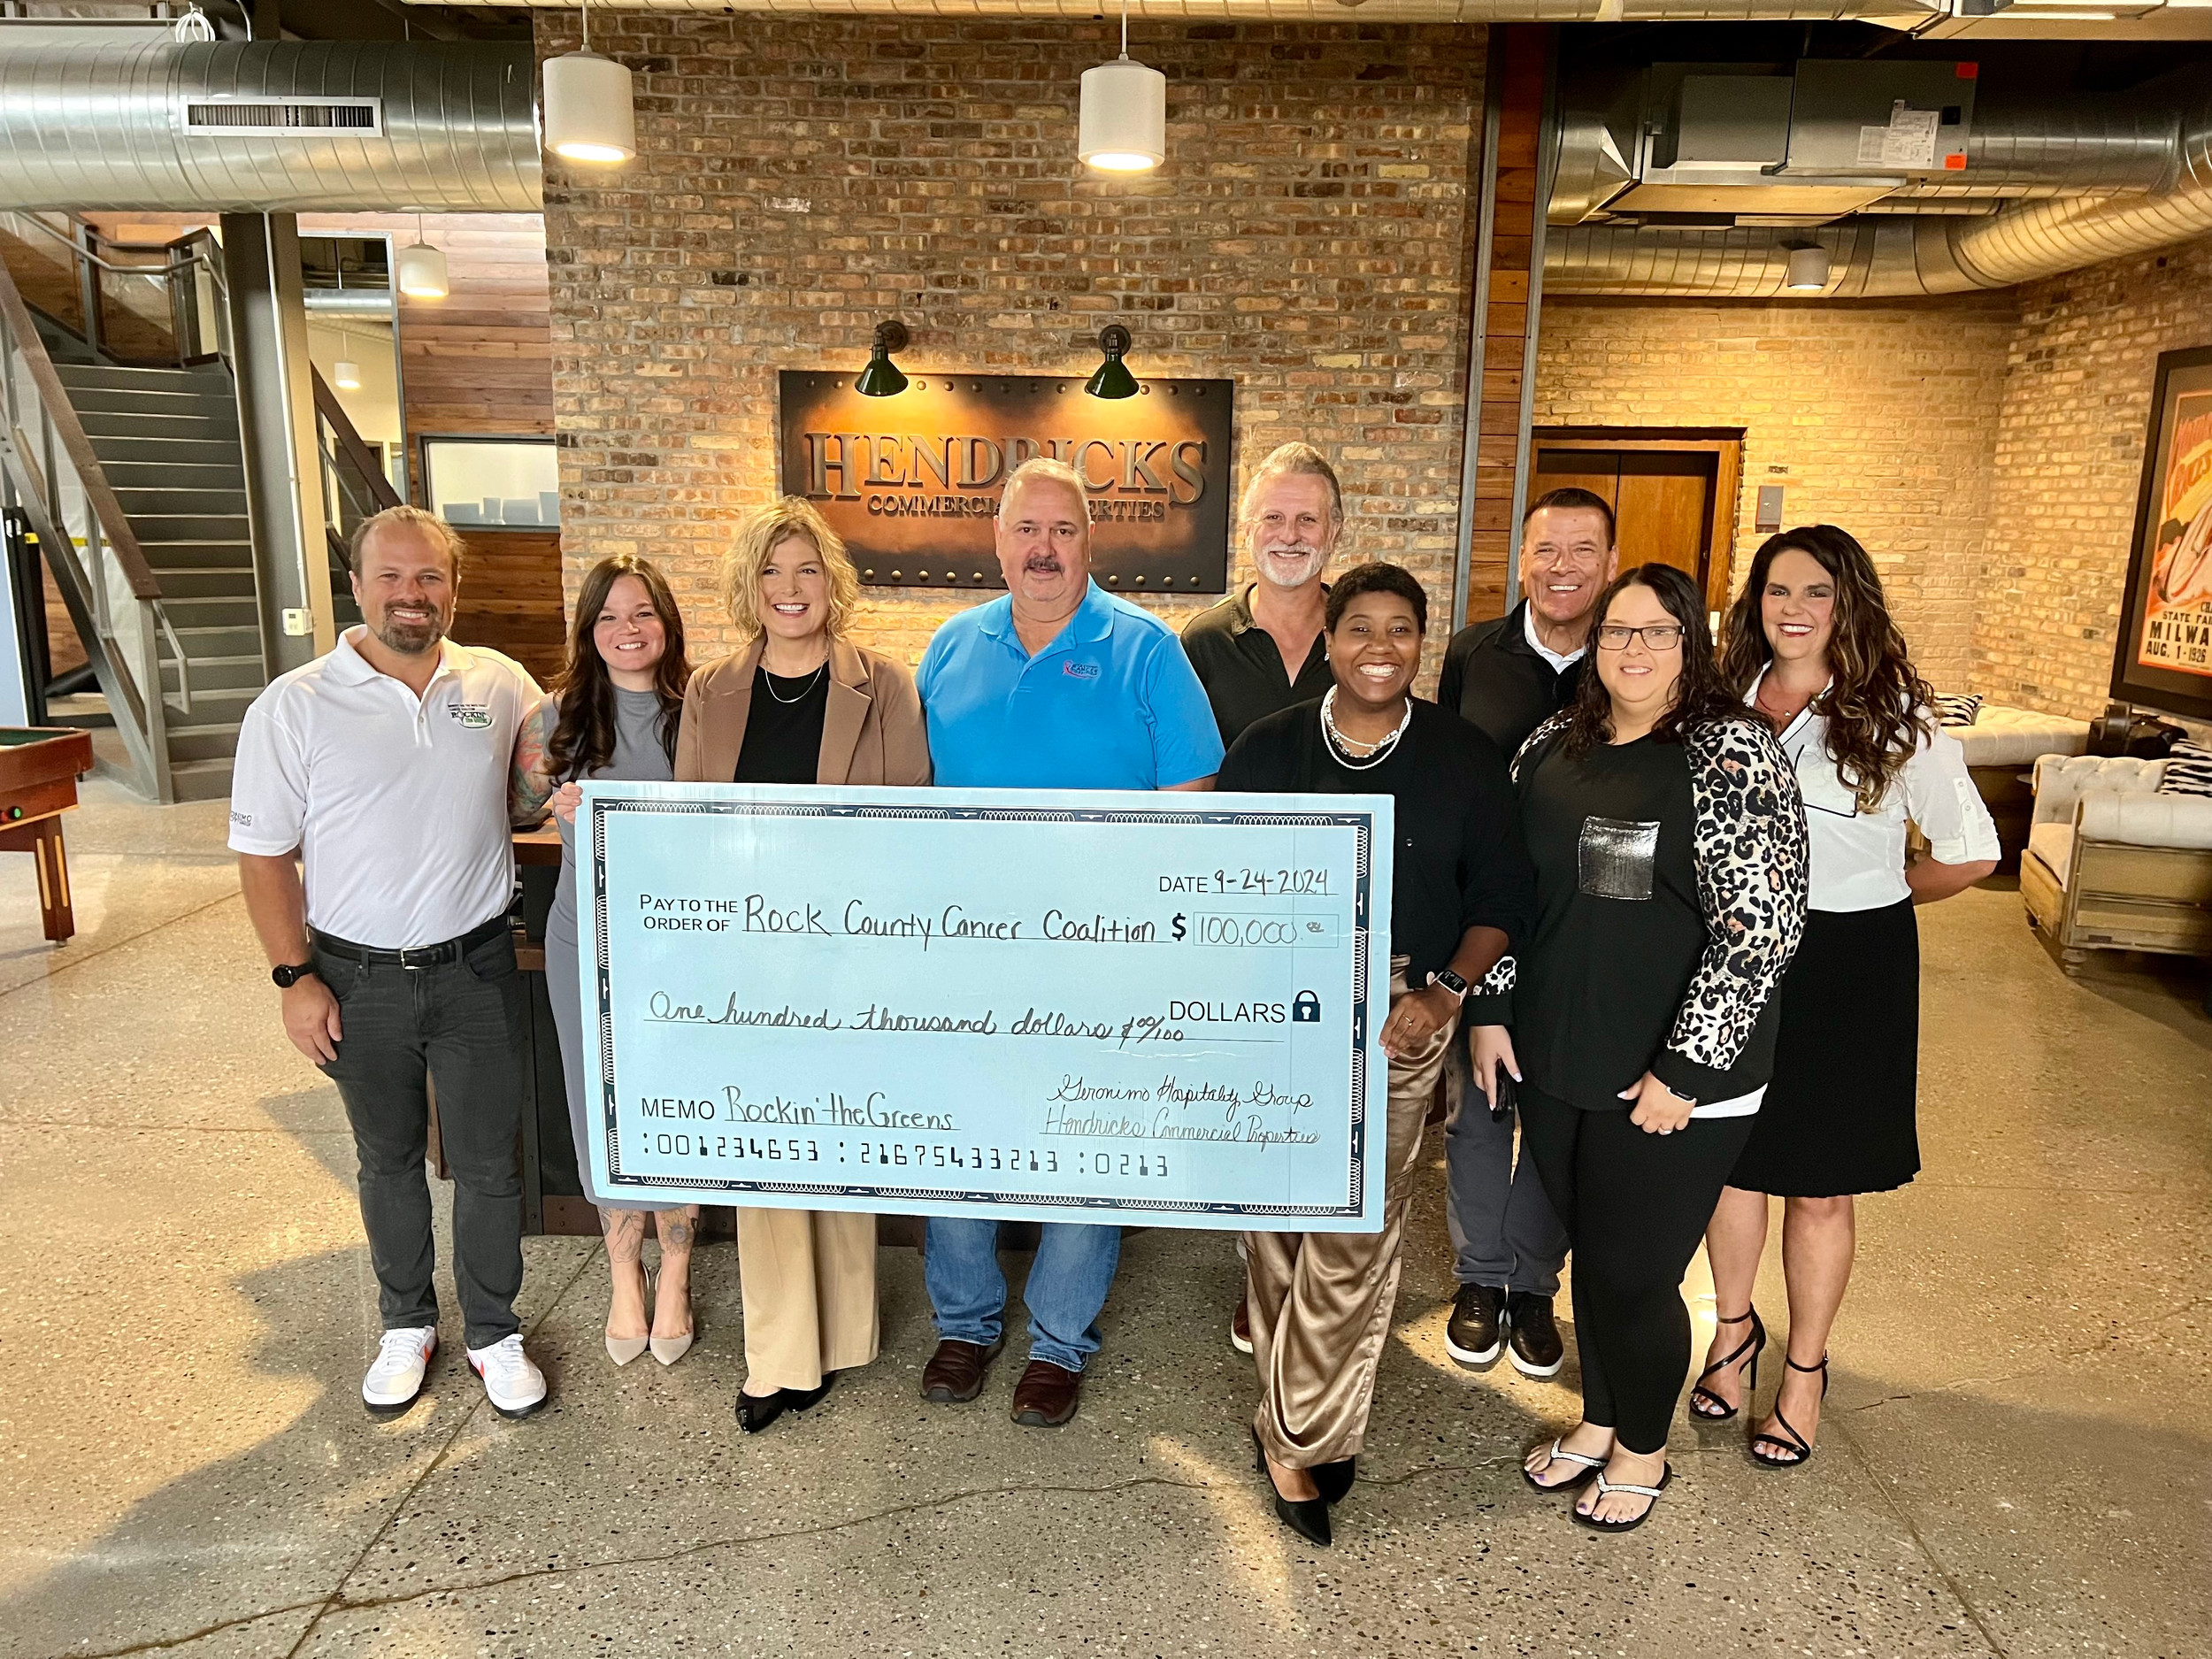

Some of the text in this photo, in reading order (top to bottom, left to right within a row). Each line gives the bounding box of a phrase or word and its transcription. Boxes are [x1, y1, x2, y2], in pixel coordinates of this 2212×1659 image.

[868, 494, 1164, 520] COMMERCI ERTIES
[2162, 611, 2191, 623] STATE
[2146, 641, 2170, 657] AUG.
[1159, 876, 1209, 893] DATE
[1214, 868, 1328, 896] 9-24-2024
[640, 894, 739, 913] PAY TO THE
[643, 916, 731, 932] ORDER OF
[744, 894, 1156, 952] Rock County Cancer Coalition
[1171, 912, 1187, 941] $
[649, 990, 706, 1020] One
[708, 991, 842, 1031] hundred
[849, 1003, 998, 1035] thousand
[1010, 1007, 1114, 1041] dollars
[1169, 1000, 1286, 1024] DOLLARS
[641, 1097, 715, 1120] MEMO
[866, 1091, 953, 1131] Greens
[1046, 1073, 1315, 1123] Geronimo Hospitality Group
[1046, 1103, 1147, 1138] Hendricks
